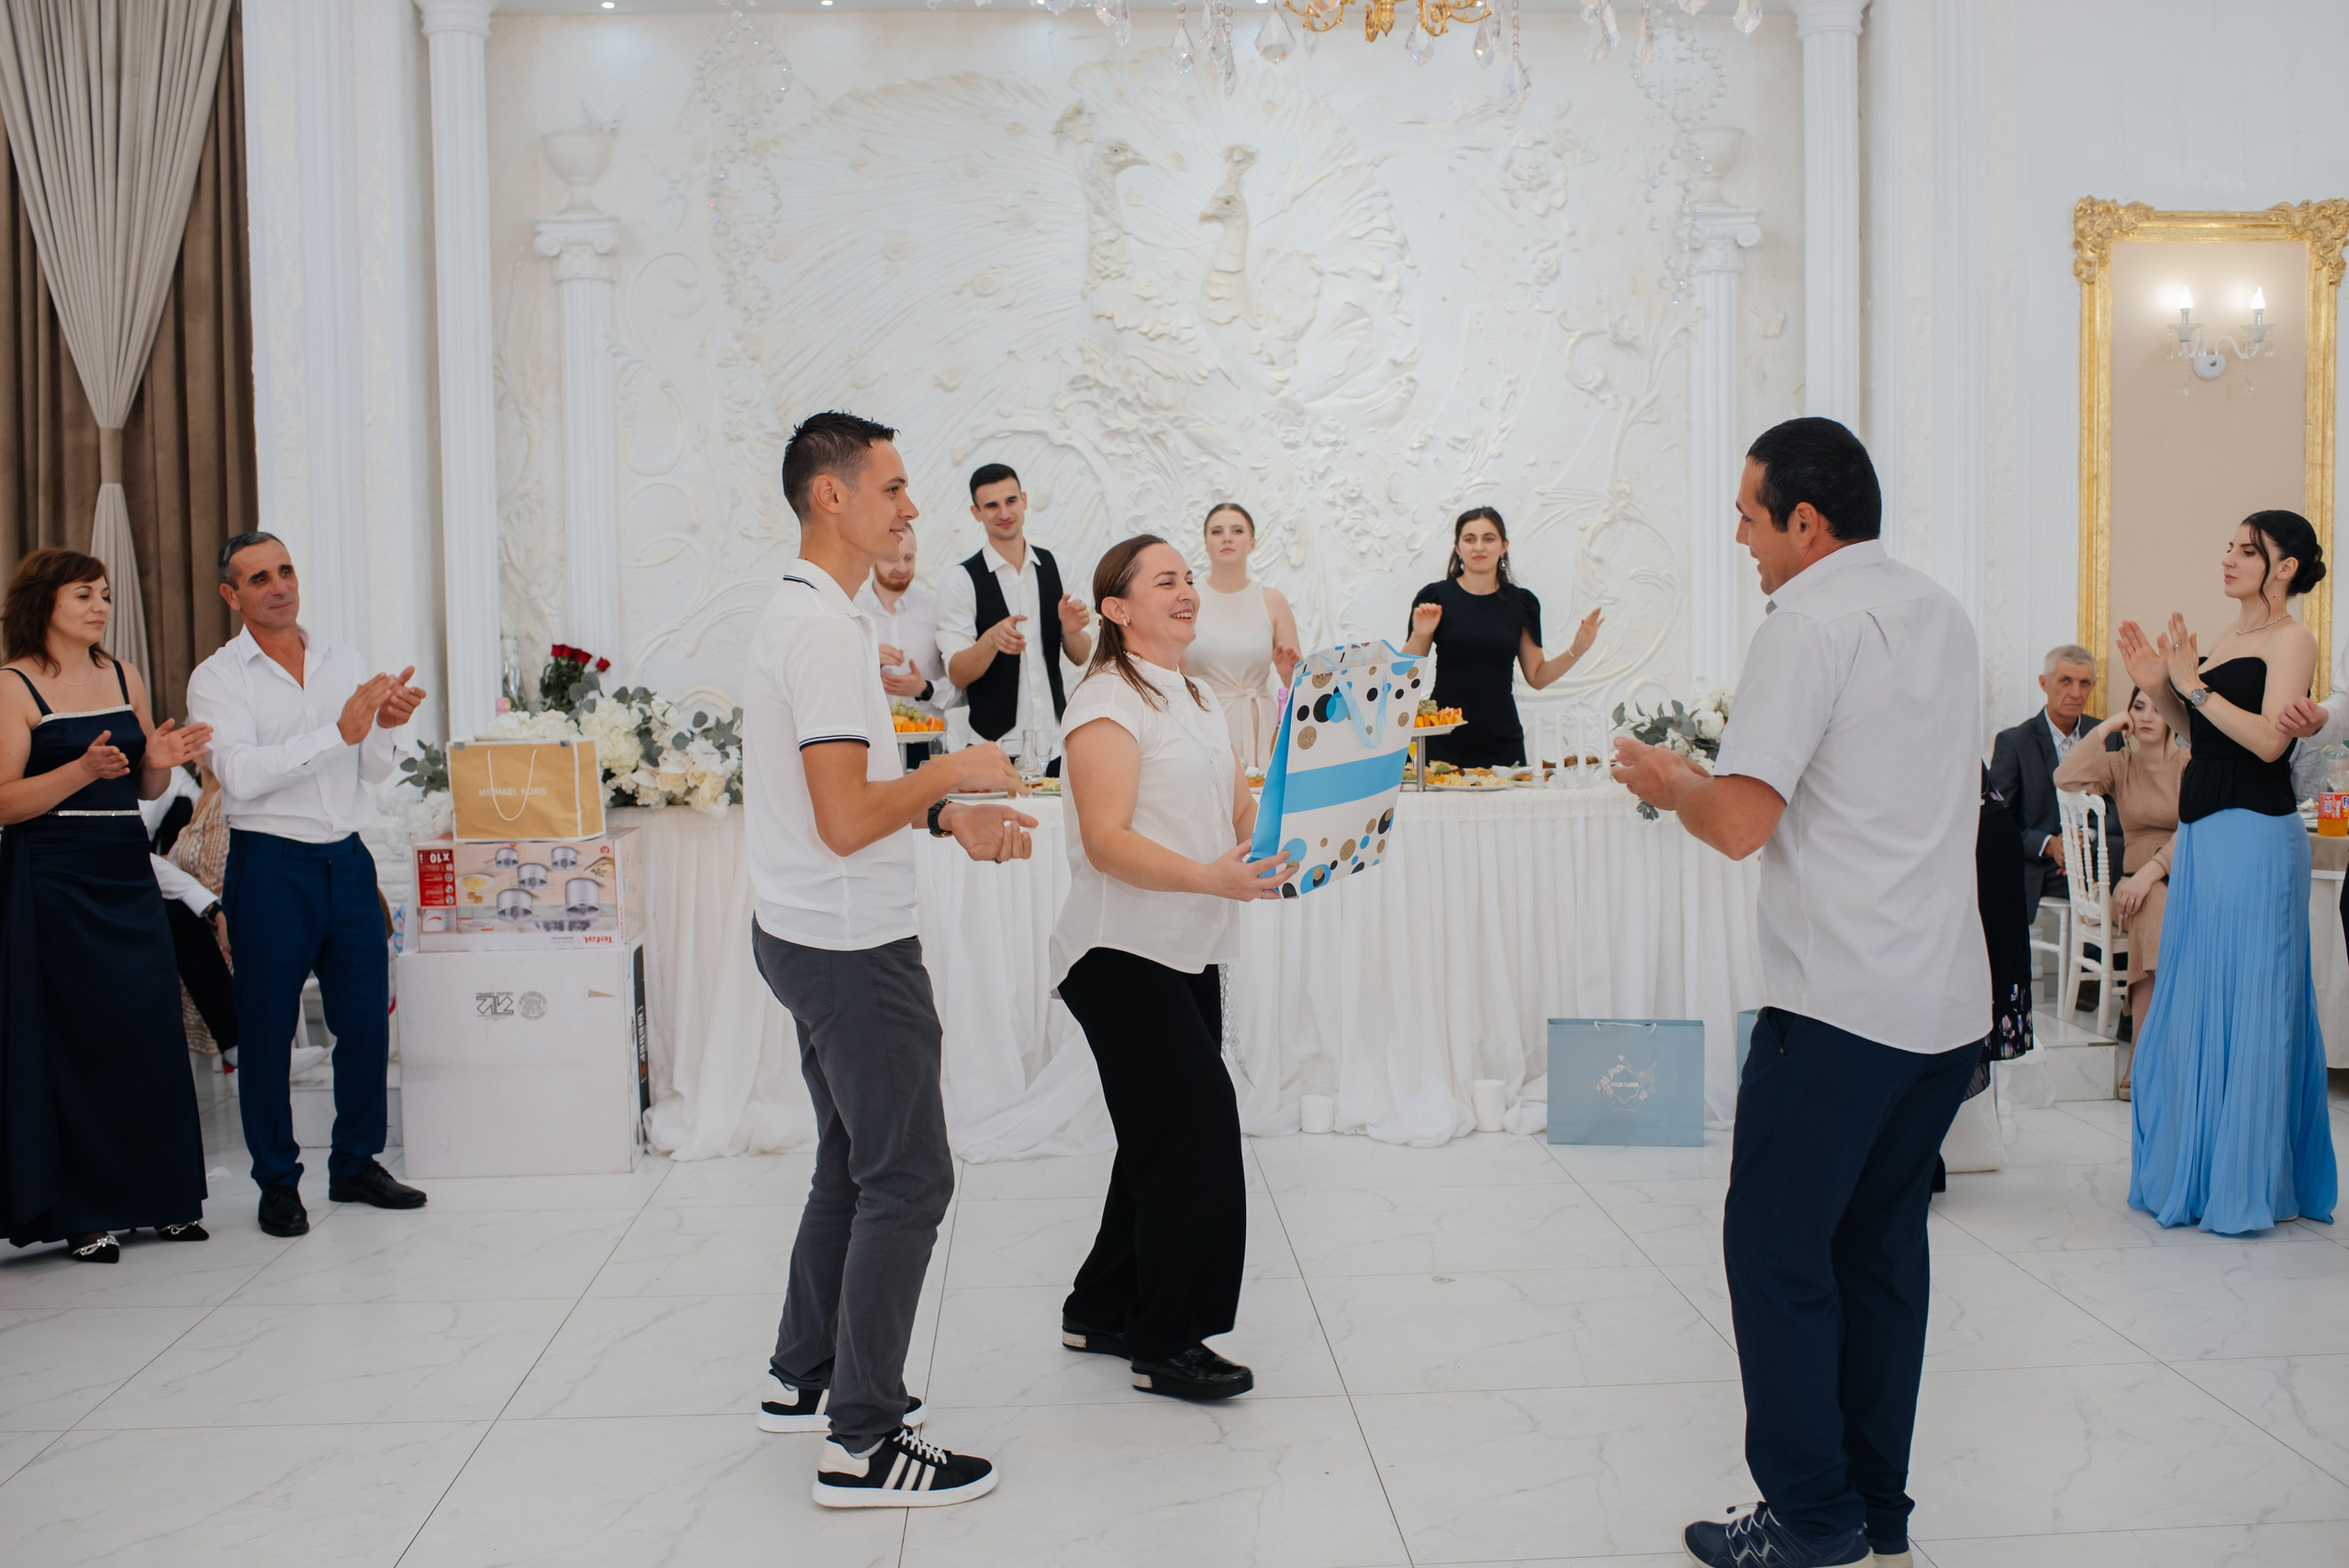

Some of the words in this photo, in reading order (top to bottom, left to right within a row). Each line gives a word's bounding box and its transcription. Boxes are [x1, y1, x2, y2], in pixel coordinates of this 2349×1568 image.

[478, 787, 518, 796] MICHAEL
[521, 786, 547, 795] KORS
[583, 935, 614, 944] Tefal
